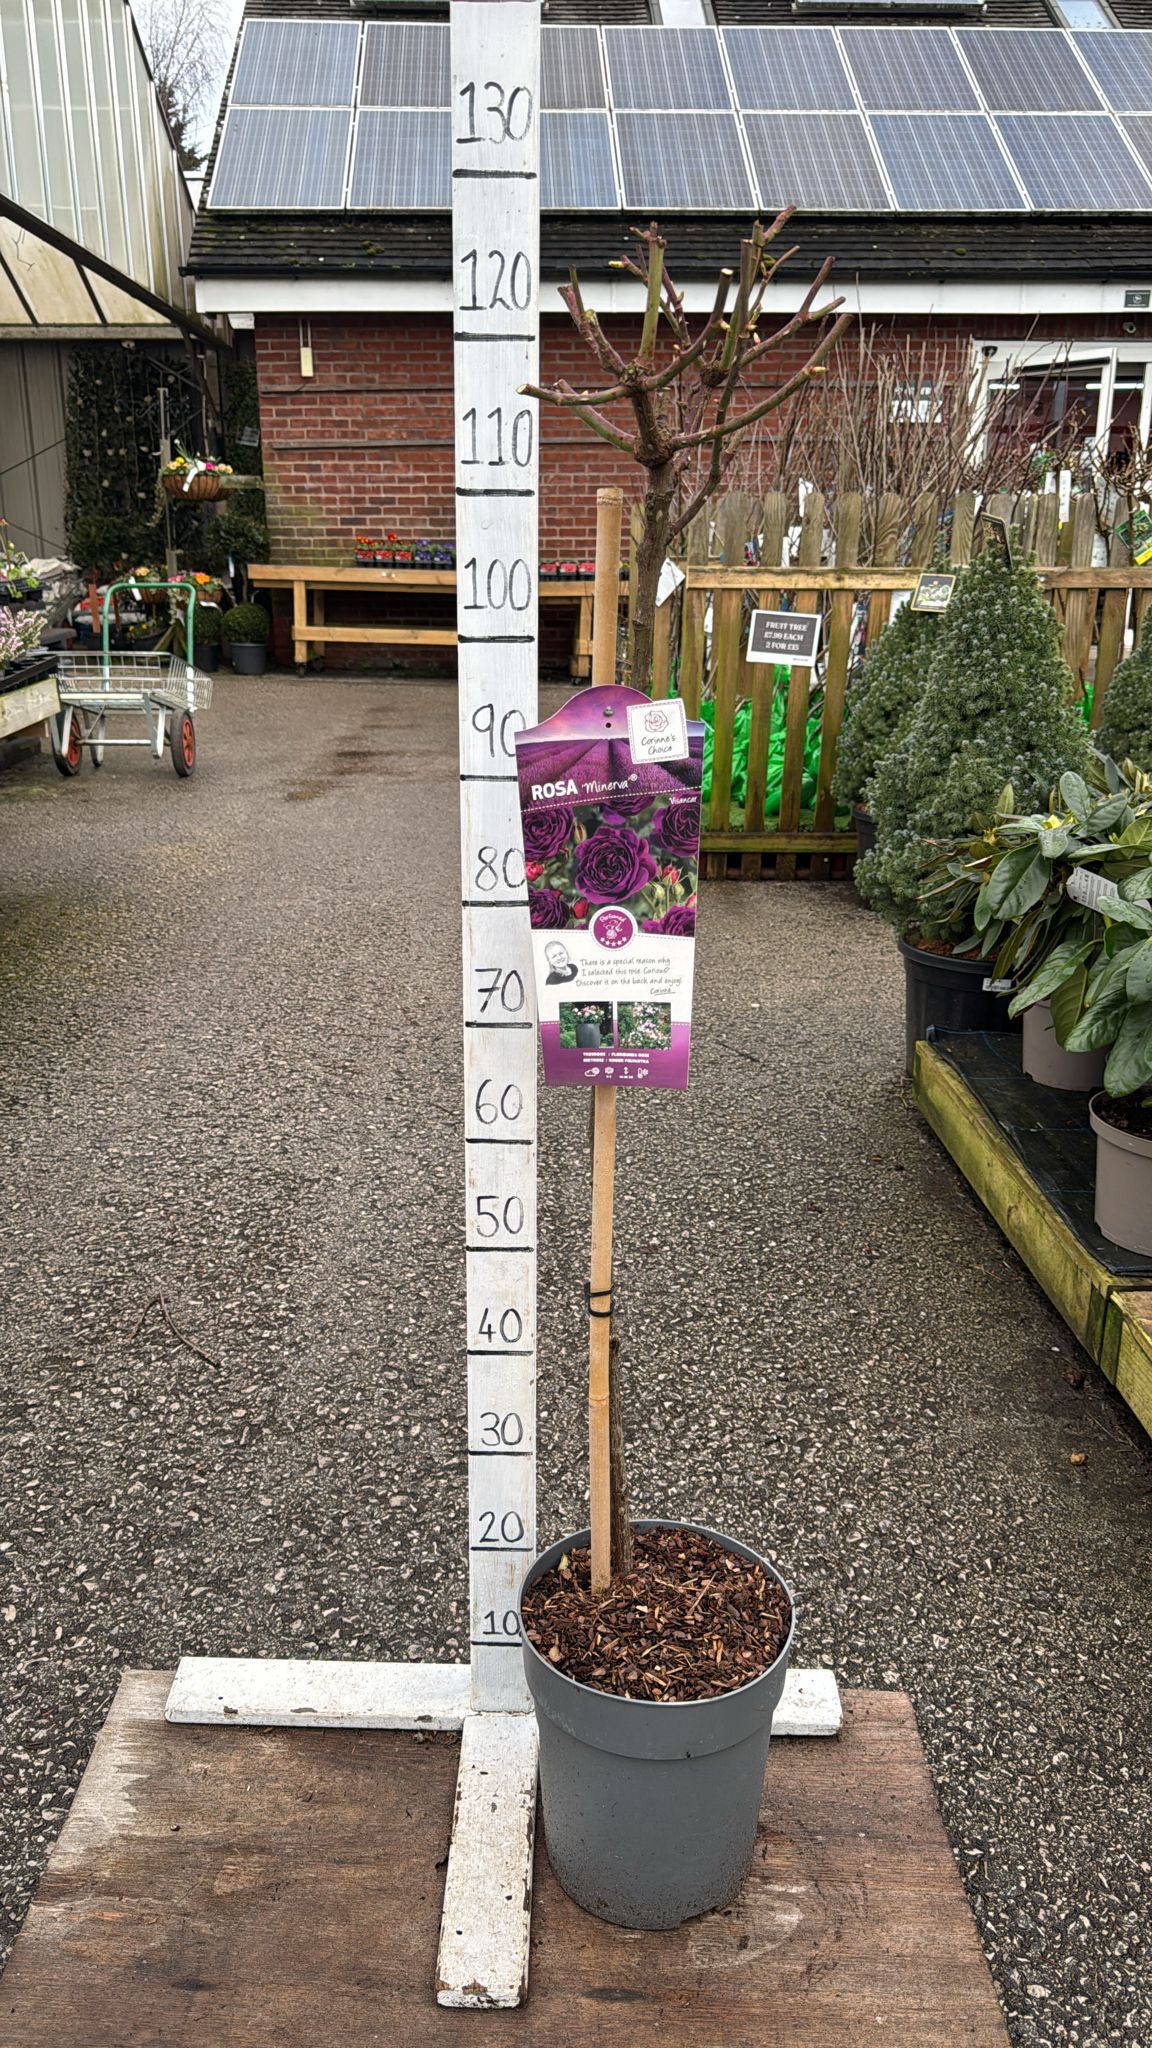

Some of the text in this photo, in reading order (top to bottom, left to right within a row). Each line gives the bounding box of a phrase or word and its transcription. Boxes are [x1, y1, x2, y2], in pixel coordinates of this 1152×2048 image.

[456, 81, 533, 144] 130
[459, 249, 532, 311] 120
[461, 407, 533, 467] 110
[463, 557, 531, 610] 100
[766, 621, 788, 630] FRUIT
[783, 633, 804, 641] EACH
[771, 642, 786, 650] FOR
[472, 703, 526, 757] 90
[641, 734, 676, 746] Corinne's
[648, 745, 673, 755] Choice
[531, 779, 578, 801] ROSA
[475, 846, 526, 891] 80
[580, 959, 598, 967] There
[612, 957, 634, 967] special
[657, 957, 670, 966] why
[588, 968, 613, 976] selected
[475, 968, 524, 1012] 70
[575, 979, 602, 987] Discover
[476, 1079, 523, 1124] 60
[476, 1195, 524, 1238] 50
[478, 1307, 522, 1343] 40
[480, 1412, 523, 1447] 30
[478, 1511, 524, 1543] 20
[482, 1610, 520, 1636] 10
